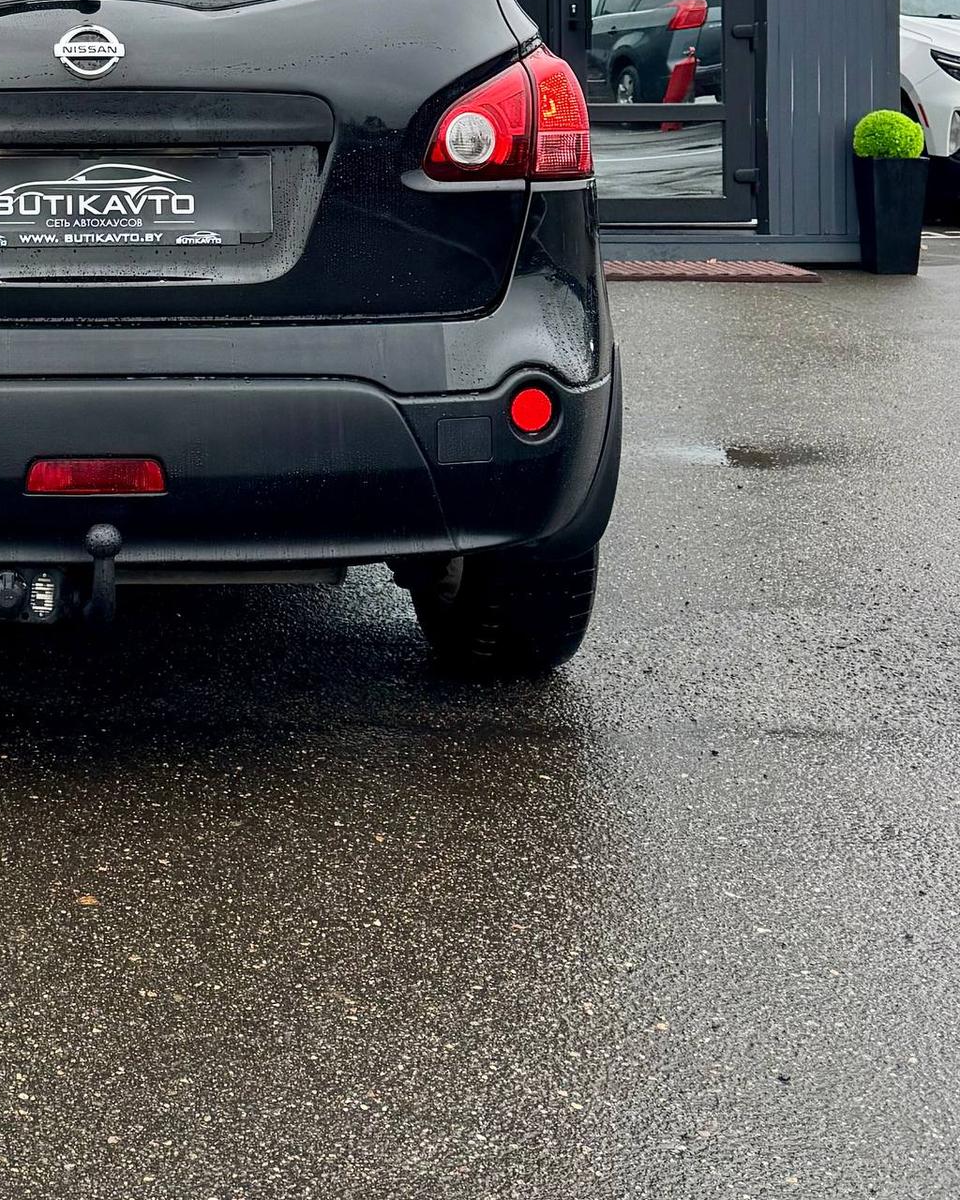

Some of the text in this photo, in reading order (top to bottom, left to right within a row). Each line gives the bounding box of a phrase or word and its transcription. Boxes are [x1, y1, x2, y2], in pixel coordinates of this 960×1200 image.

[62, 44, 118, 54] NISSAN
[45, 218, 143, 228] СЕТЬ АВТОХАУСОВ
[19, 233, 163, 243] WWW. BUTIKAVTO.BY
